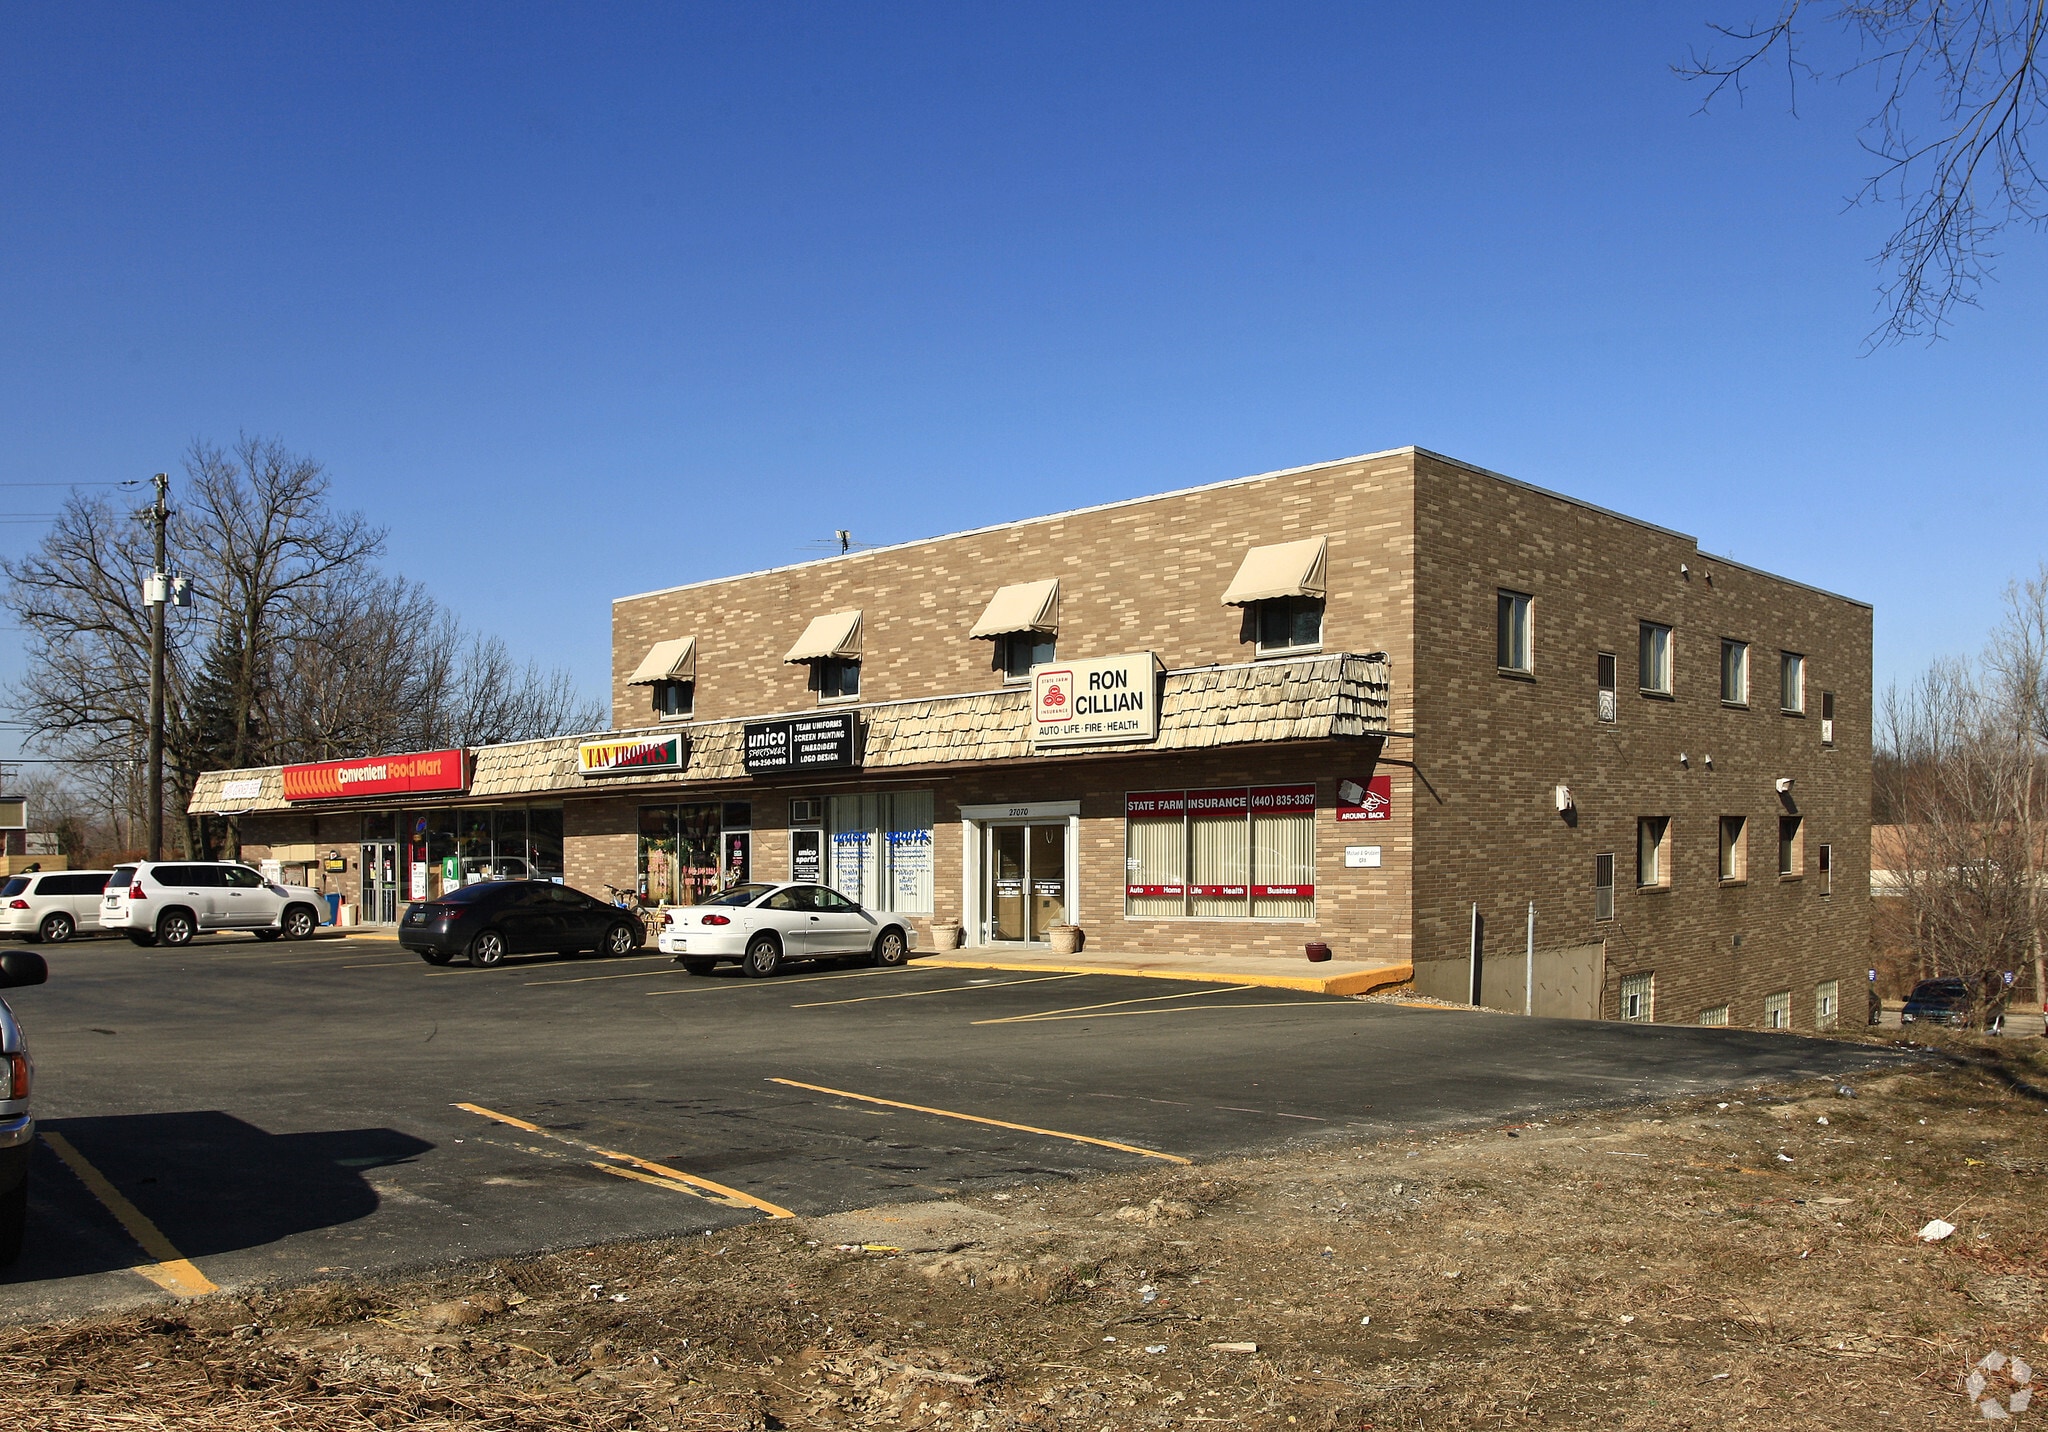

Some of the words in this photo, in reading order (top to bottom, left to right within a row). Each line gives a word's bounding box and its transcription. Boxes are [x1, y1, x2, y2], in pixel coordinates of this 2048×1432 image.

[1090, 670, 1127, 690] RON
[1076, 692, 1143, 715] CILLIAN
[796, 723, 811, 731] TEAM
[812, 720, 842, 730] UNIFORMS
[1039, 726, 1059, 735] AUTO
[1064, 724, 1080, 734] LIFE
[1085, 723, 1102, 732] FIRE
[1107, 720, 1138, 731] HEALTH
[749, 727, 786, 747] unico
[794, 733, 816, 742] SCREEN
[818, 730, 845, 740] PRINTING
[749, 747, 786, 758] SPORTSWEAR
[801, 742, 837, 752] EMBROIDERY
[587, 747, 610, 768] TAN
[614, 743, 668, 766] TROPICS
[800, 755, 816, 763] LOGO
[817, 753, 839, 762] DESIGN
[338, 764, 386, 784] Convenient
[387, 760, 416, 778] Food
[417, 758, 442, 776] Mart
[1128, 801, 1154, 811] STATE
[1158, 800, 1183, 810] FARM
[1188, 797, 1246, 809] INSURANCE
[1251, 795, 1274, 807] (440)
[1276, 794, 1315, 805] 835-3367
[1009, 808, 1029, 816] 27070
[1342, 812, 1366, 820] AROUND
[1368, 811, 1385, 819] BACK
[833, 828, 869, 843] unico
[885, 828, 929, 844] sports
[798, 848, 817, 856] unico
[796, 856, 817, 864] sports
[1129, 886, 1144, 894] Auto
[1163, 886, 1181, 894] Home
[1267, 886, 1297, 894] Business
